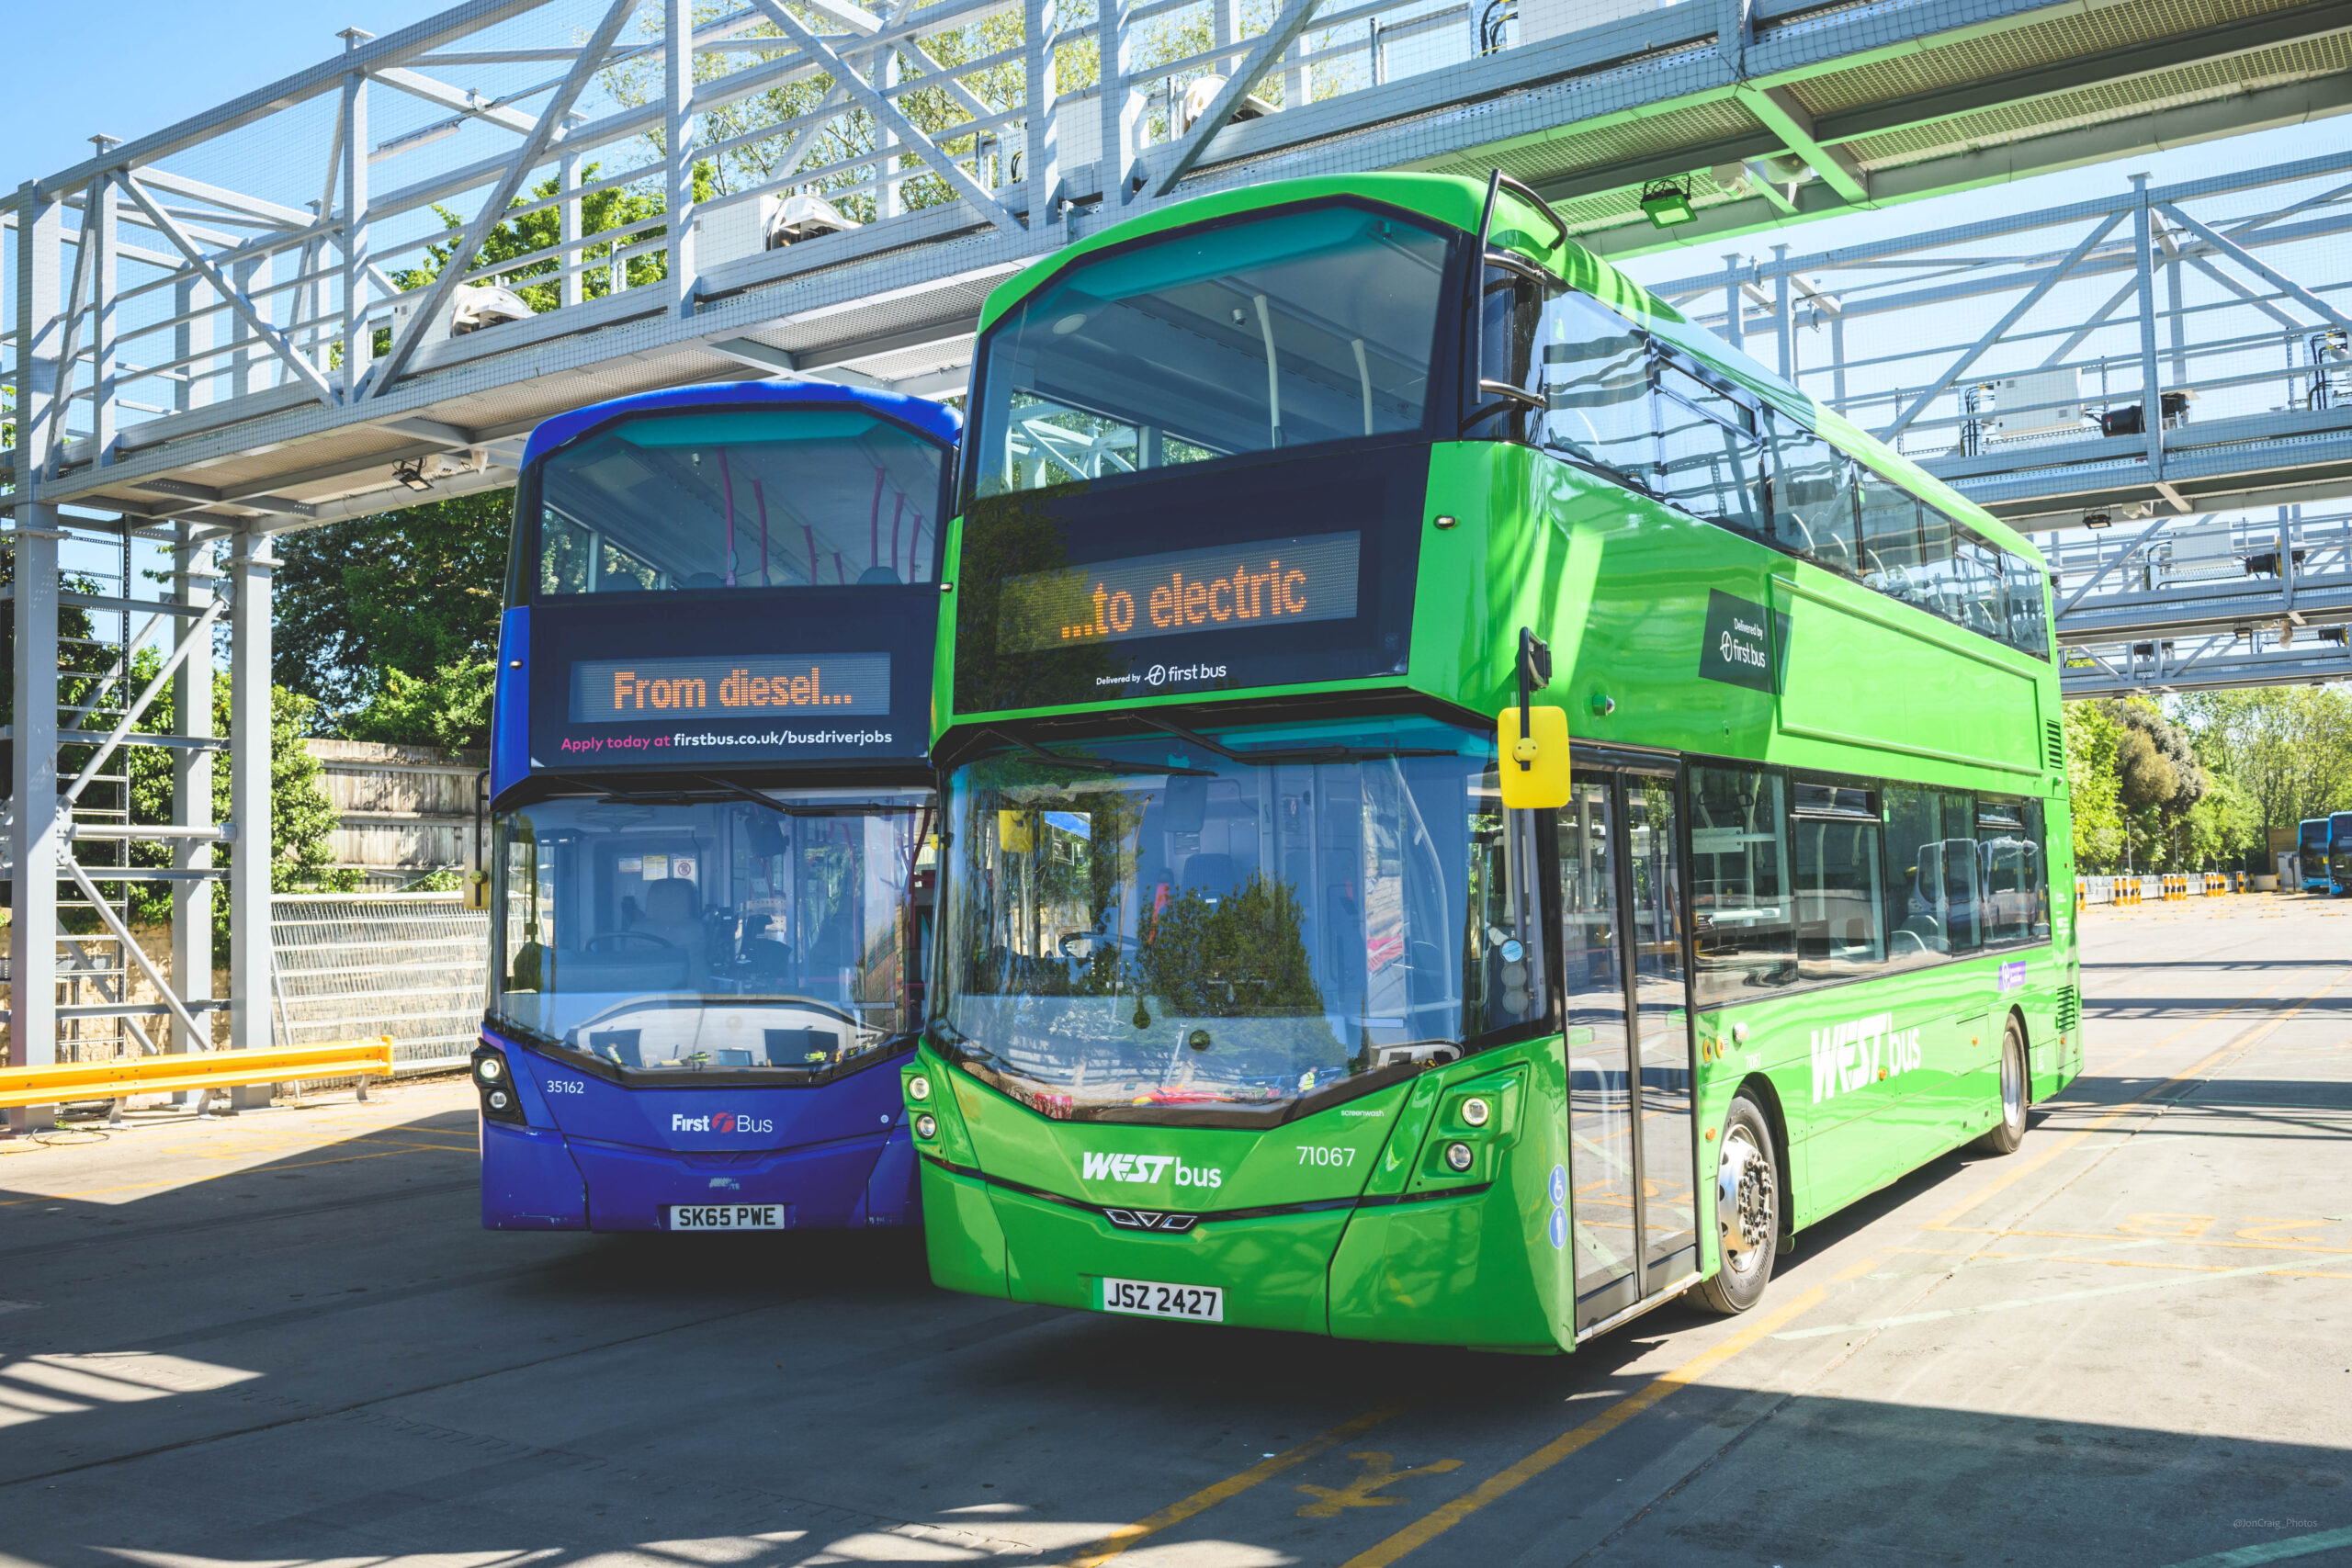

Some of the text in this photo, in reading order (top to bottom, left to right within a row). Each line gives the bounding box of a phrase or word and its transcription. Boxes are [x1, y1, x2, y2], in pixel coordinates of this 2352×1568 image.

[1150, 560, 1307, 628] electric
[1733, 617, 1763, 640] Delivered by
[1733, 638, 1766, 669] first bus
[1096, 673, 1141, 685] Delivered by
[1168, 663, 1227, 682] first bus
[614, 667, 853, 710] From diesel...
[560, 730, 893, 753] Apply today at firstbus.co.uk/busdriverjobs
[1811, 1011, 1921, 1105] WEST bus
[547, 1080, 584, 1095] 35162
[672, 1113, 773, 1133] First Bus
[1340, 1110, 1384, 1118] screenwash
[1296, 1146, 1356, 1168] 71067
[1082, 1151, 1222, 1189] WEST bus
[678, 1207, 776, 1227] SK65 PWE
[1107, 1282, 1217, 1316] JSZ 2427
